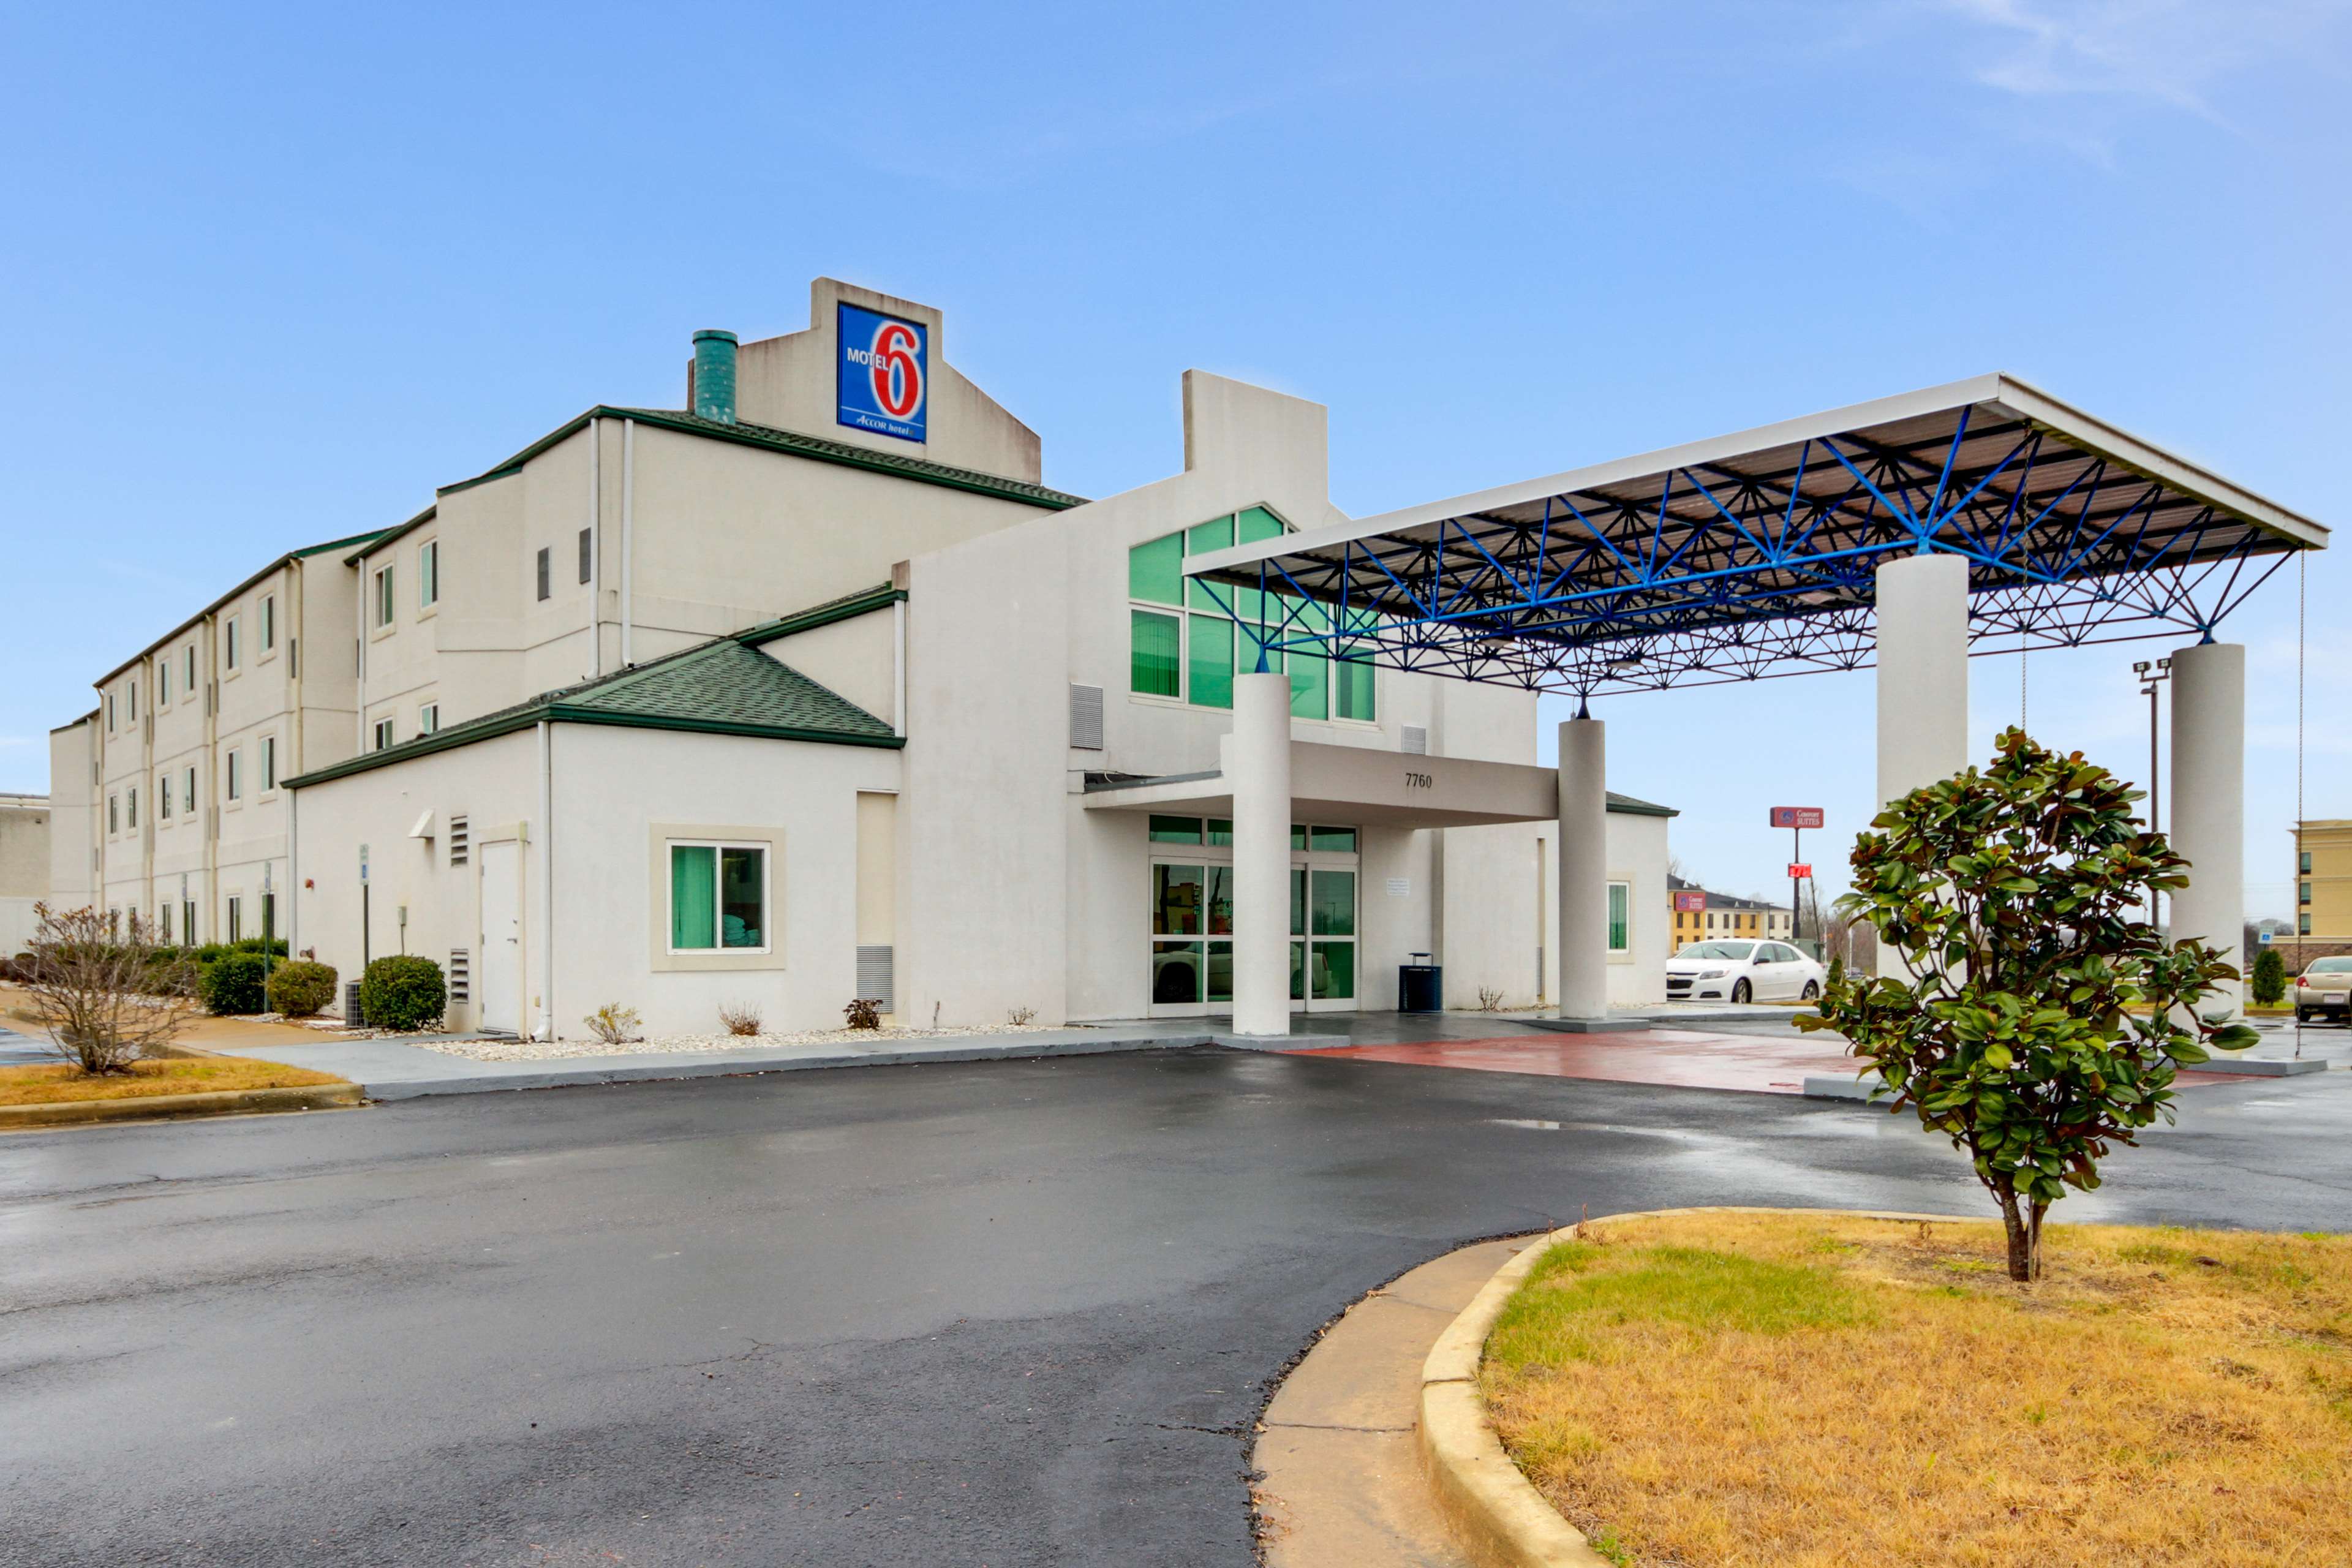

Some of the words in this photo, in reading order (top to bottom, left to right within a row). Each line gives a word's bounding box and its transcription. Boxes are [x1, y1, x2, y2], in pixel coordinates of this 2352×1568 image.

[847, 347, 889, 371] MOTEL
[872, 322, 921, 418] 6
[1406, 772, 1432, 788] 7760
